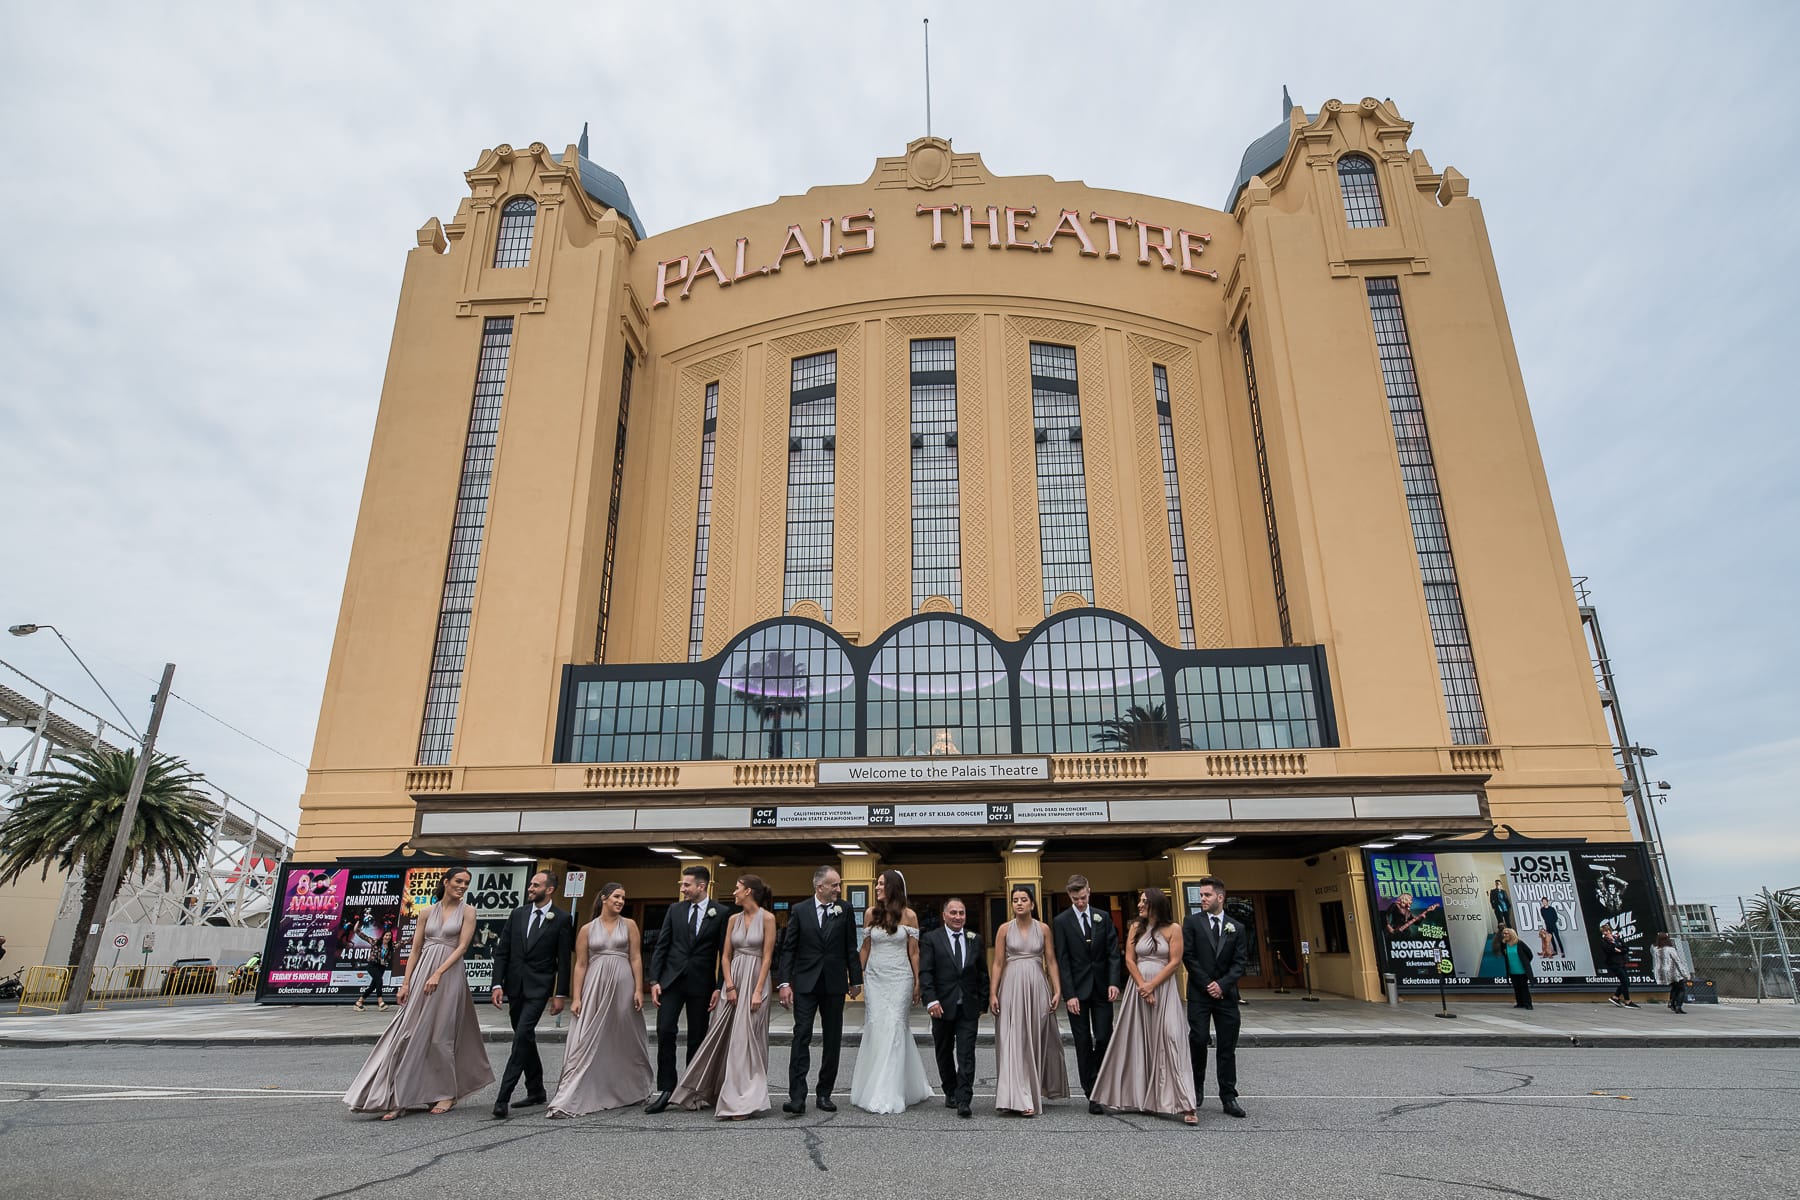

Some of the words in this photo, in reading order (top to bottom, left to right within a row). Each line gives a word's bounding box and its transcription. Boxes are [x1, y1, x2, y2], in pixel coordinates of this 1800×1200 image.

[653, 208, 876, 310] PALAIS
[915, 202, 1220, 282] THEATRE
[849, 767, 906, 779] Welcome
[910, 767, 923, 778] to
[927, 767, 948, 778] the
[952, 765, 987, 777] Palais
[990, 764, 1039, 776] Theatre
[757, 809, 773, 817] OCT
[1374, 858, 1437, 881] SUZI
[1510, 855, 1568, 873] JOSH
[410, 880, 423, 888] ST
[477, 873, 513, 891] IAN
[1440, 872, 1479, 884] Hannah
[1510, 872, 1571, 883] THOMAS
[360, 881, 389, 894] STATE
[1378, 881, 1441, 898] QUATRO
[1442, 884, 1480, 899] Gadsby
[1513, 883, 1575, 902] WHOOPSIE
[290, 895, 337, 911] MANIA
[345, 895, 400, 906] CHAMPIONSHIPS
[415, 896, 427, 904] 23
[466, 891, 520, 910] MOSS
[1516, 901, 1578, 931] DASY
[1391, 941, 1436, 950] MONDAY
[1438, 940, 1446, 949] 4
[1541, 961, 1554, 972] SAT
[1555, 961, 1561, 971] 9
[1562, 960, 1576, 971] NOV
[271, 973, 291, 981] FRIDAY
[299, 973, 329, 981] NOVEMBER
